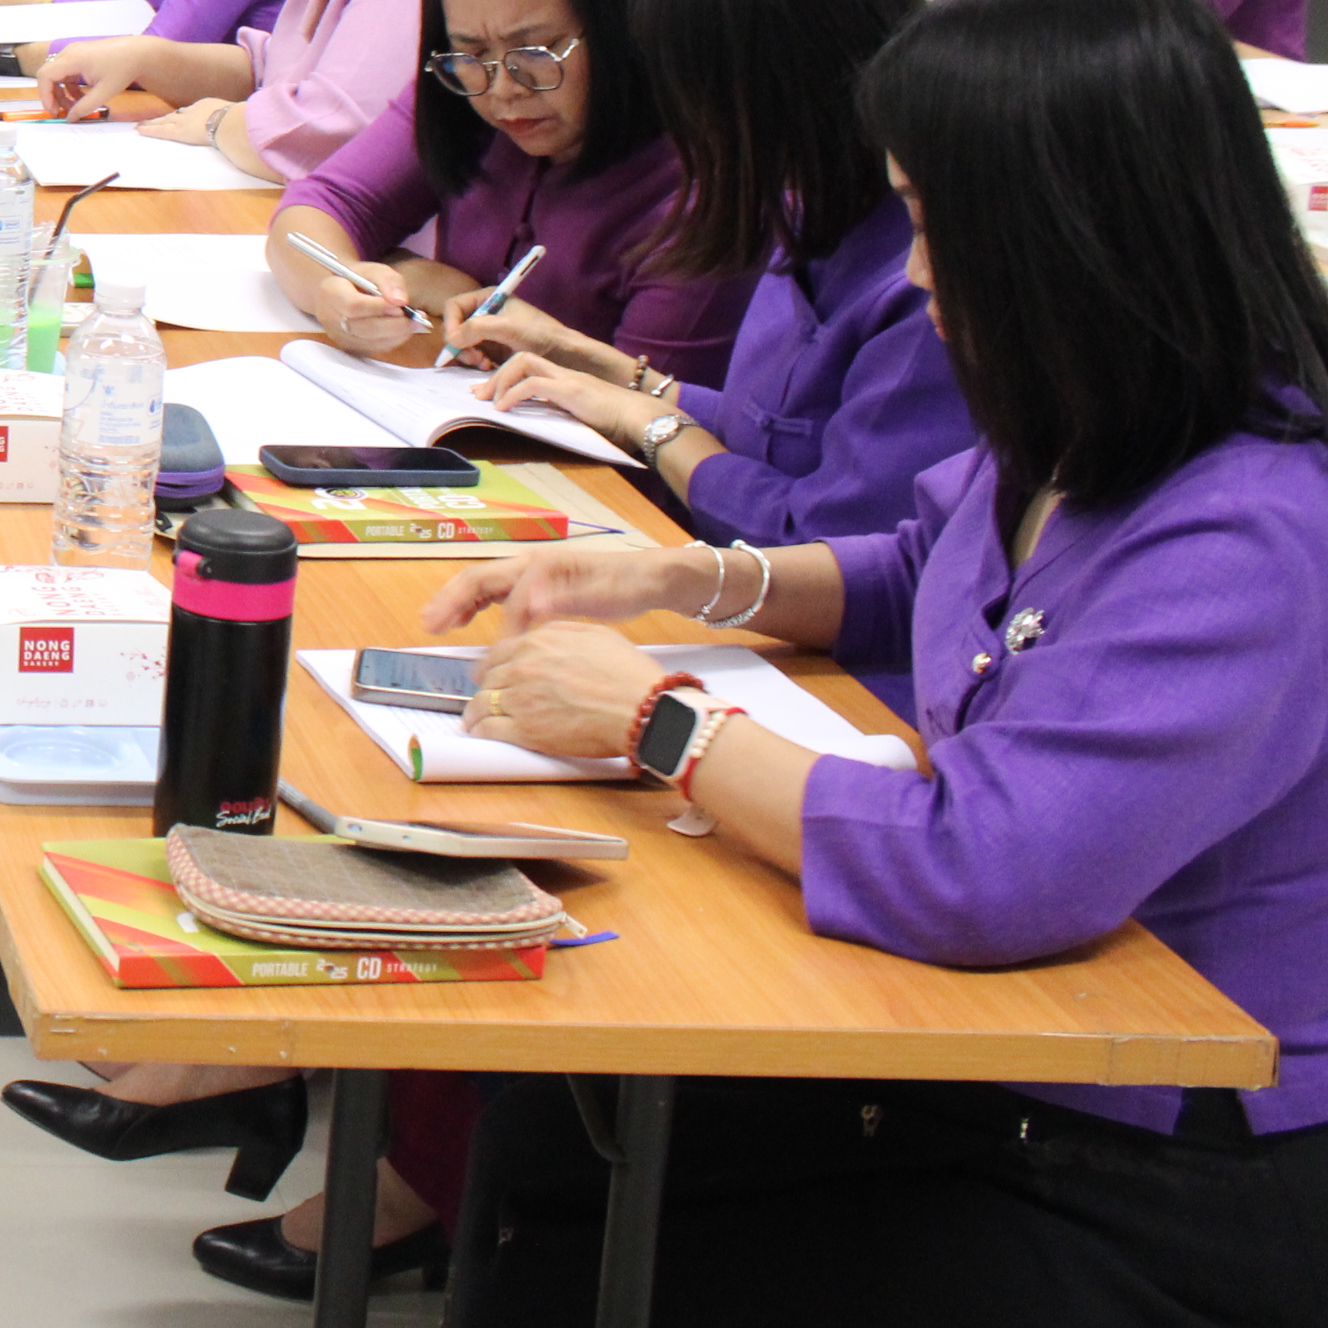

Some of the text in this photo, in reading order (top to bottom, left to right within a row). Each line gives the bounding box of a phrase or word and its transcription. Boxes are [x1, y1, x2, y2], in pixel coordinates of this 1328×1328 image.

[365, 525, 404, 536] PORTABLE
[437, 523, 455, 539] CD
[458, 526, 493, 534] STRATEGY
[31, 586, 80, 616] NONG
[61, 586, 107, 616] DAENG
[24, 640, 71, 651] NONG
[24, 651, 71, 660] DAENG
[251, 962, 309, 977] PORTABLE
[357, 957, 383, 980] CD
[387, 963, 438, 973] STRATEGY
